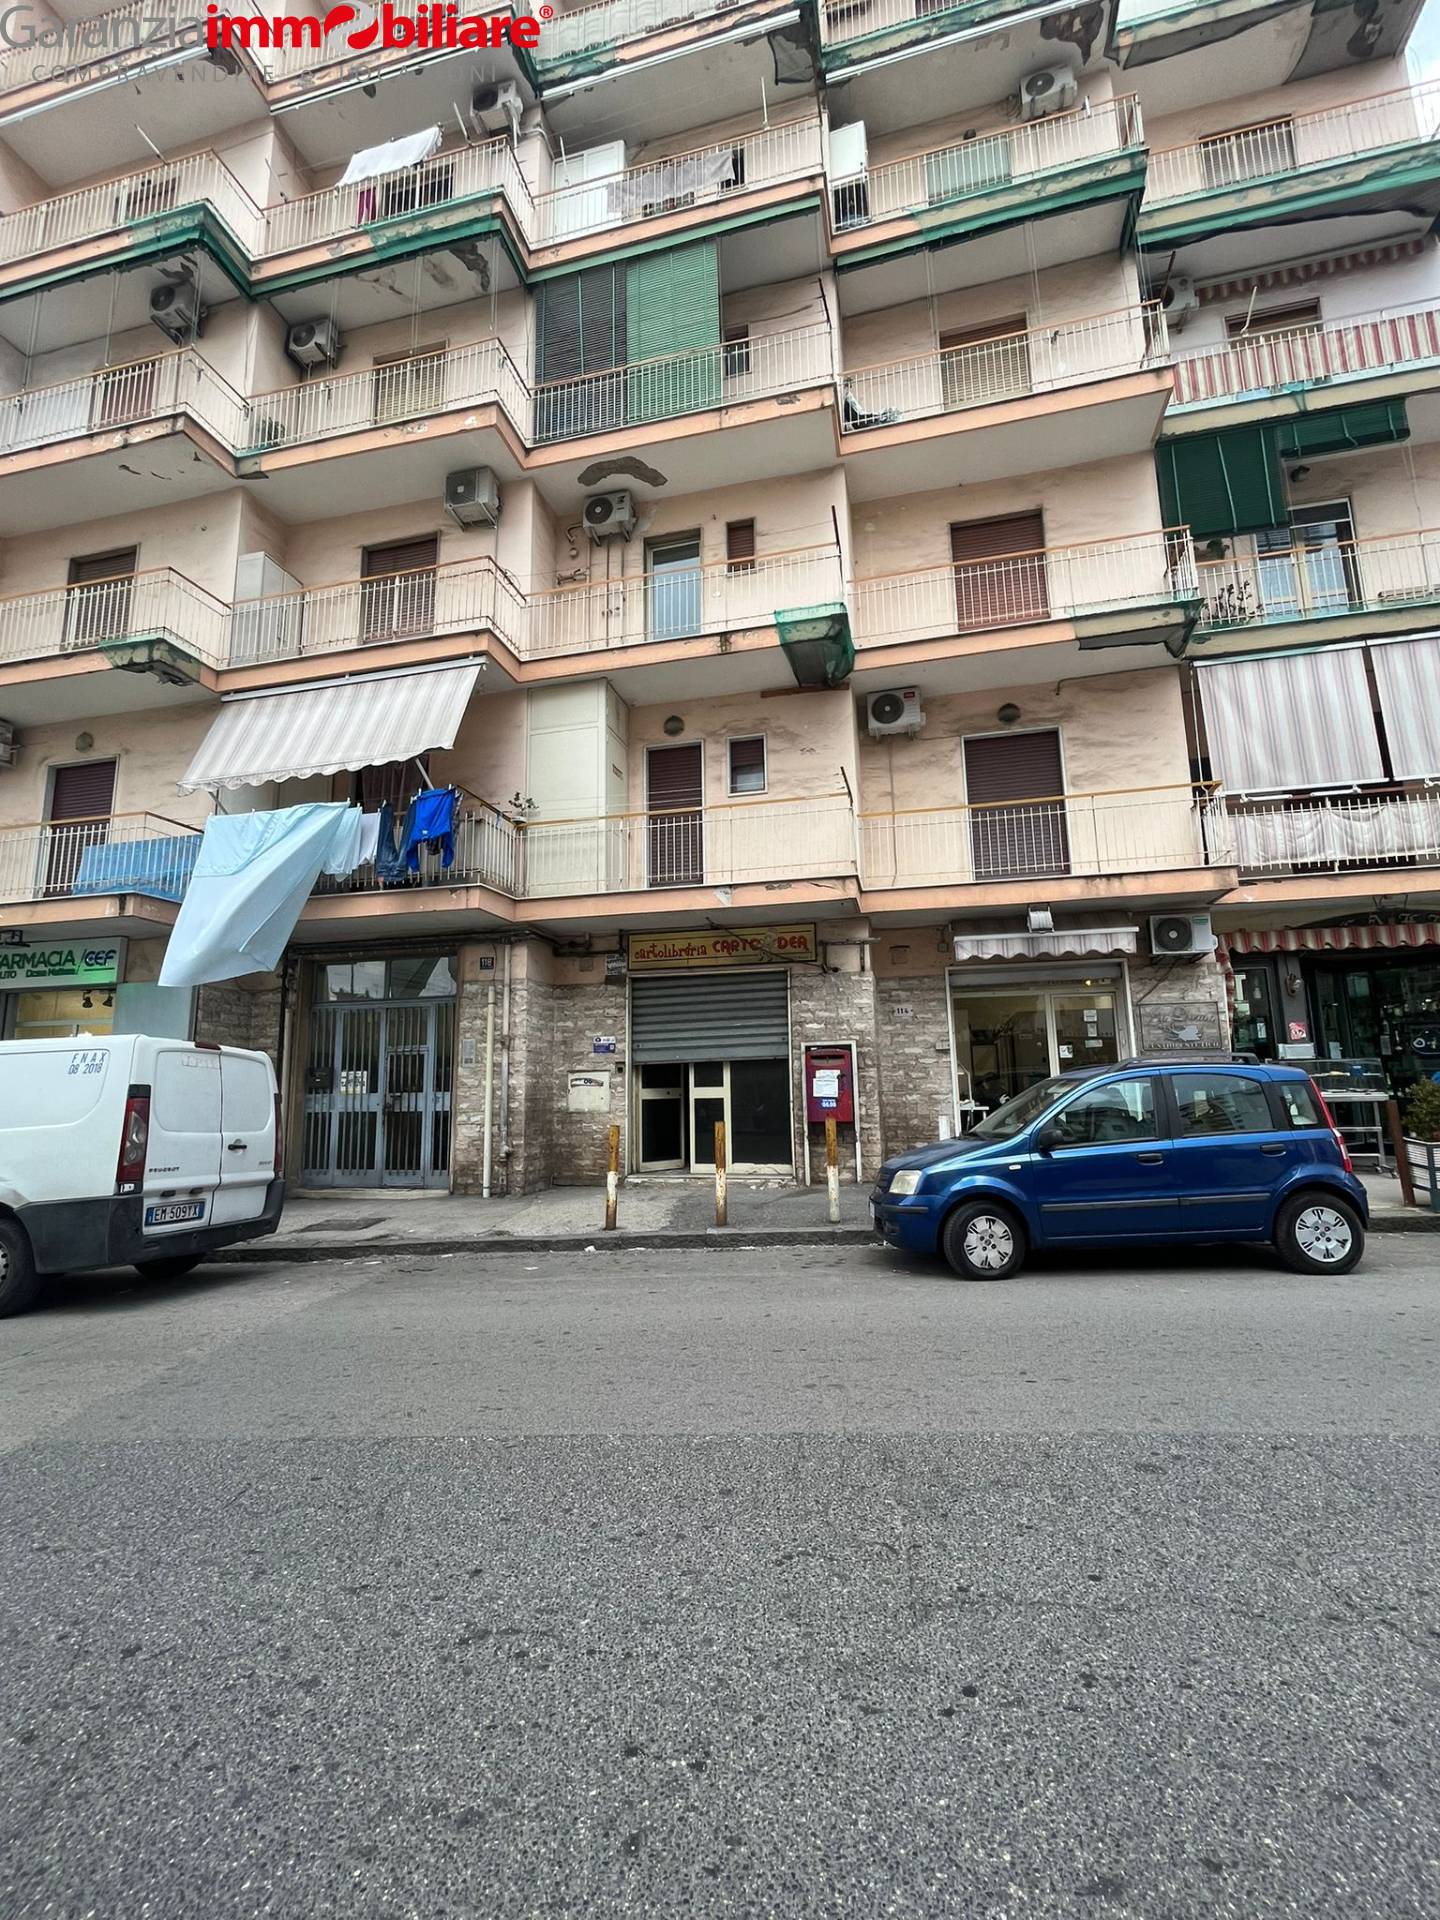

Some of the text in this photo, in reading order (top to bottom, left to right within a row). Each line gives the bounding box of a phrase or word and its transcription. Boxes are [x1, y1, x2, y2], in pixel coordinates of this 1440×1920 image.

[0, 949, 76, 970] ARMACIA
[154, 1204, 200, 1221] EM 509YX
